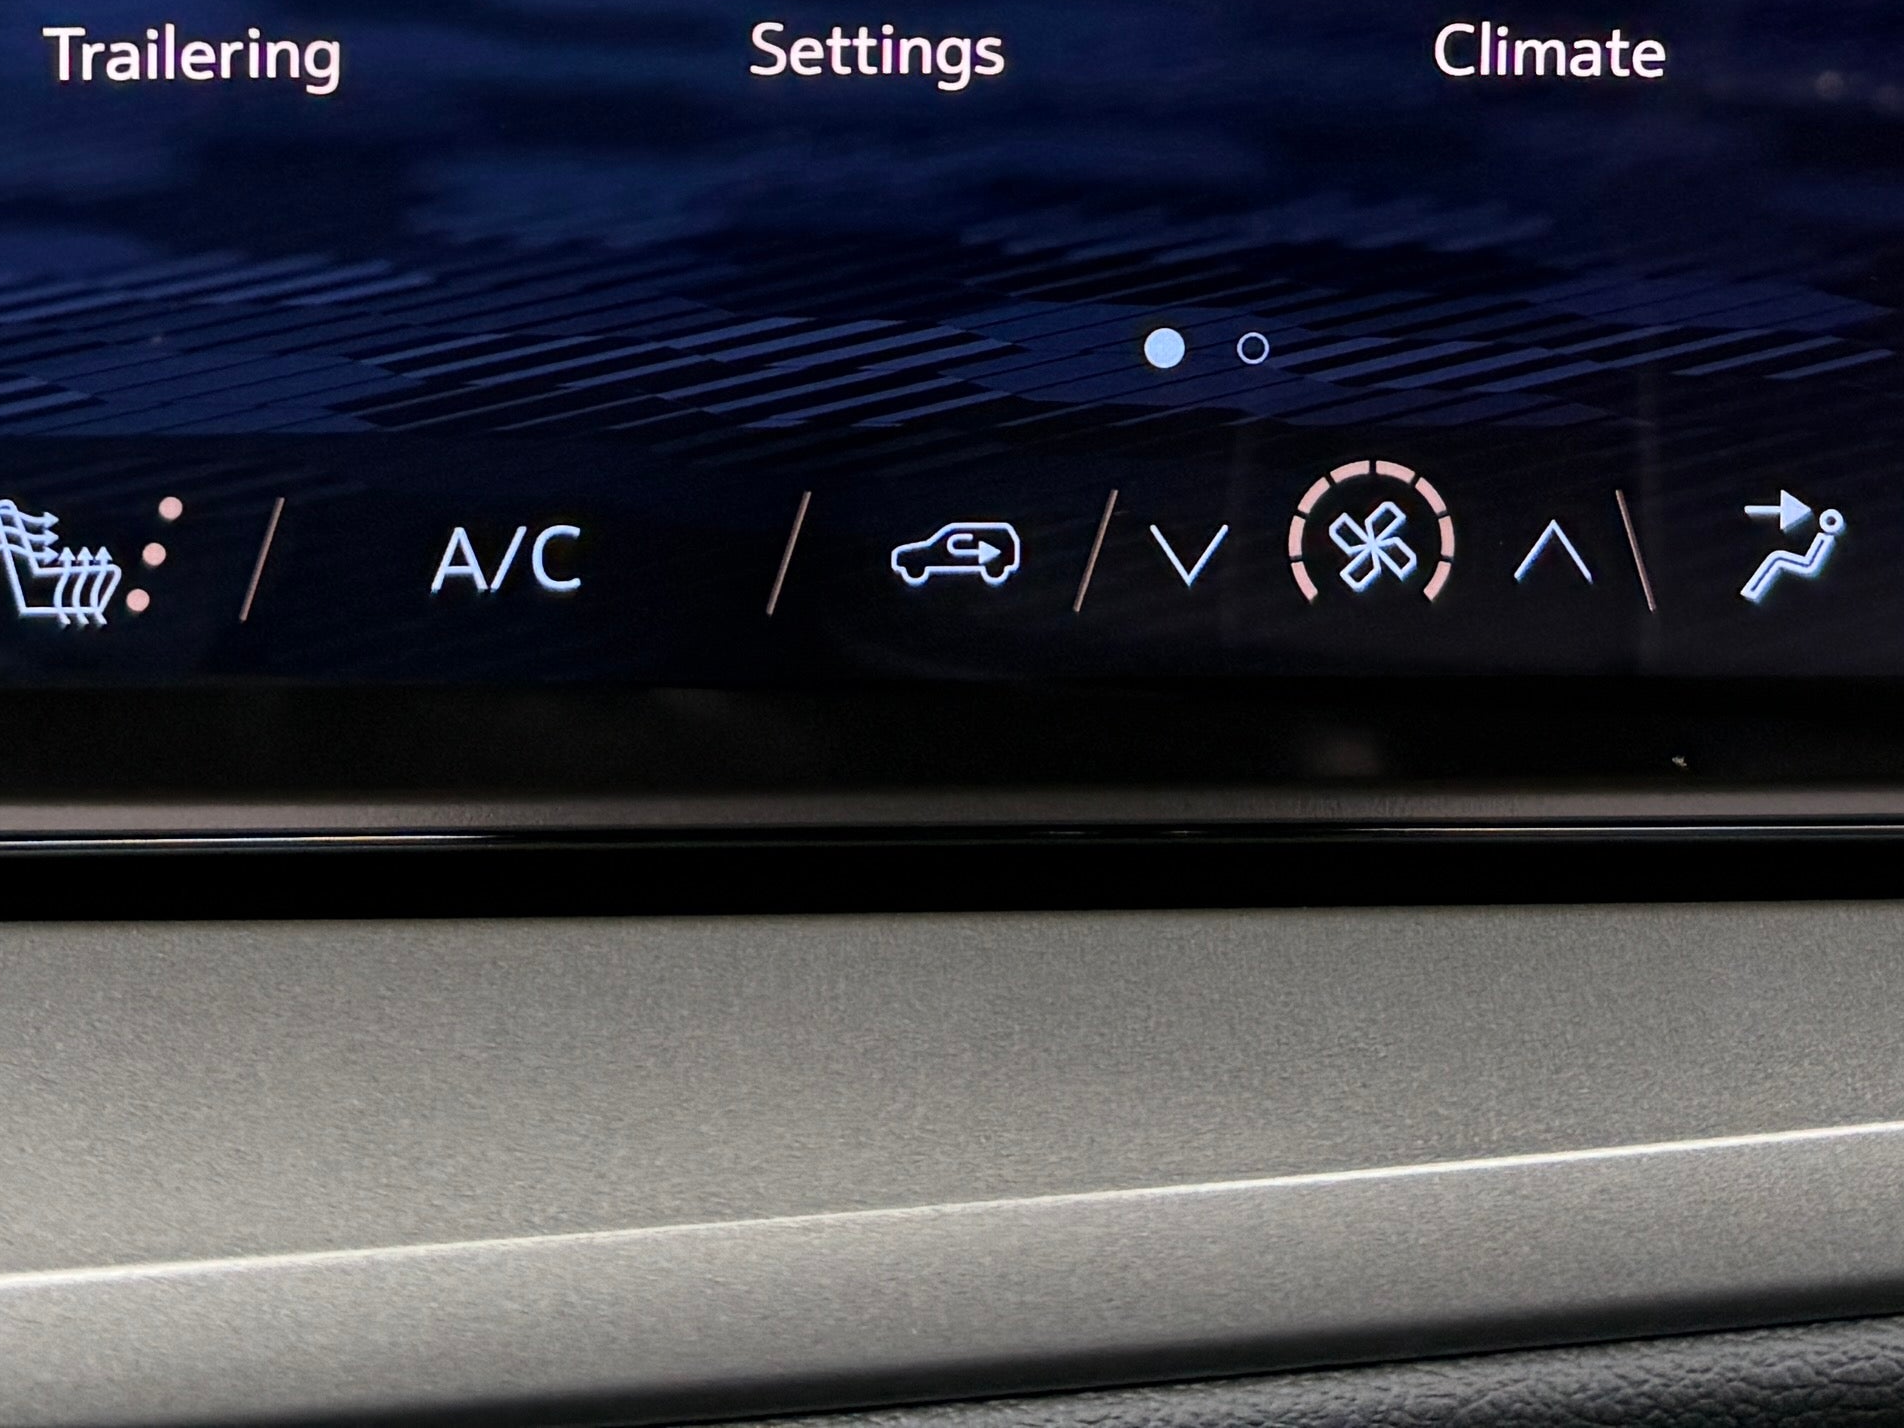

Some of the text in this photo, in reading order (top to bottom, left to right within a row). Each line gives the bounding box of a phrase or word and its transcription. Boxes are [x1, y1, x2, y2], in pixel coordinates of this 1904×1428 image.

[41, 22, 341, 96] Trailering
[749, 21, 1006, 92] Settings
[1433, 19, 1667, 79] Climate
[429, 523, 583, 594] A/C
